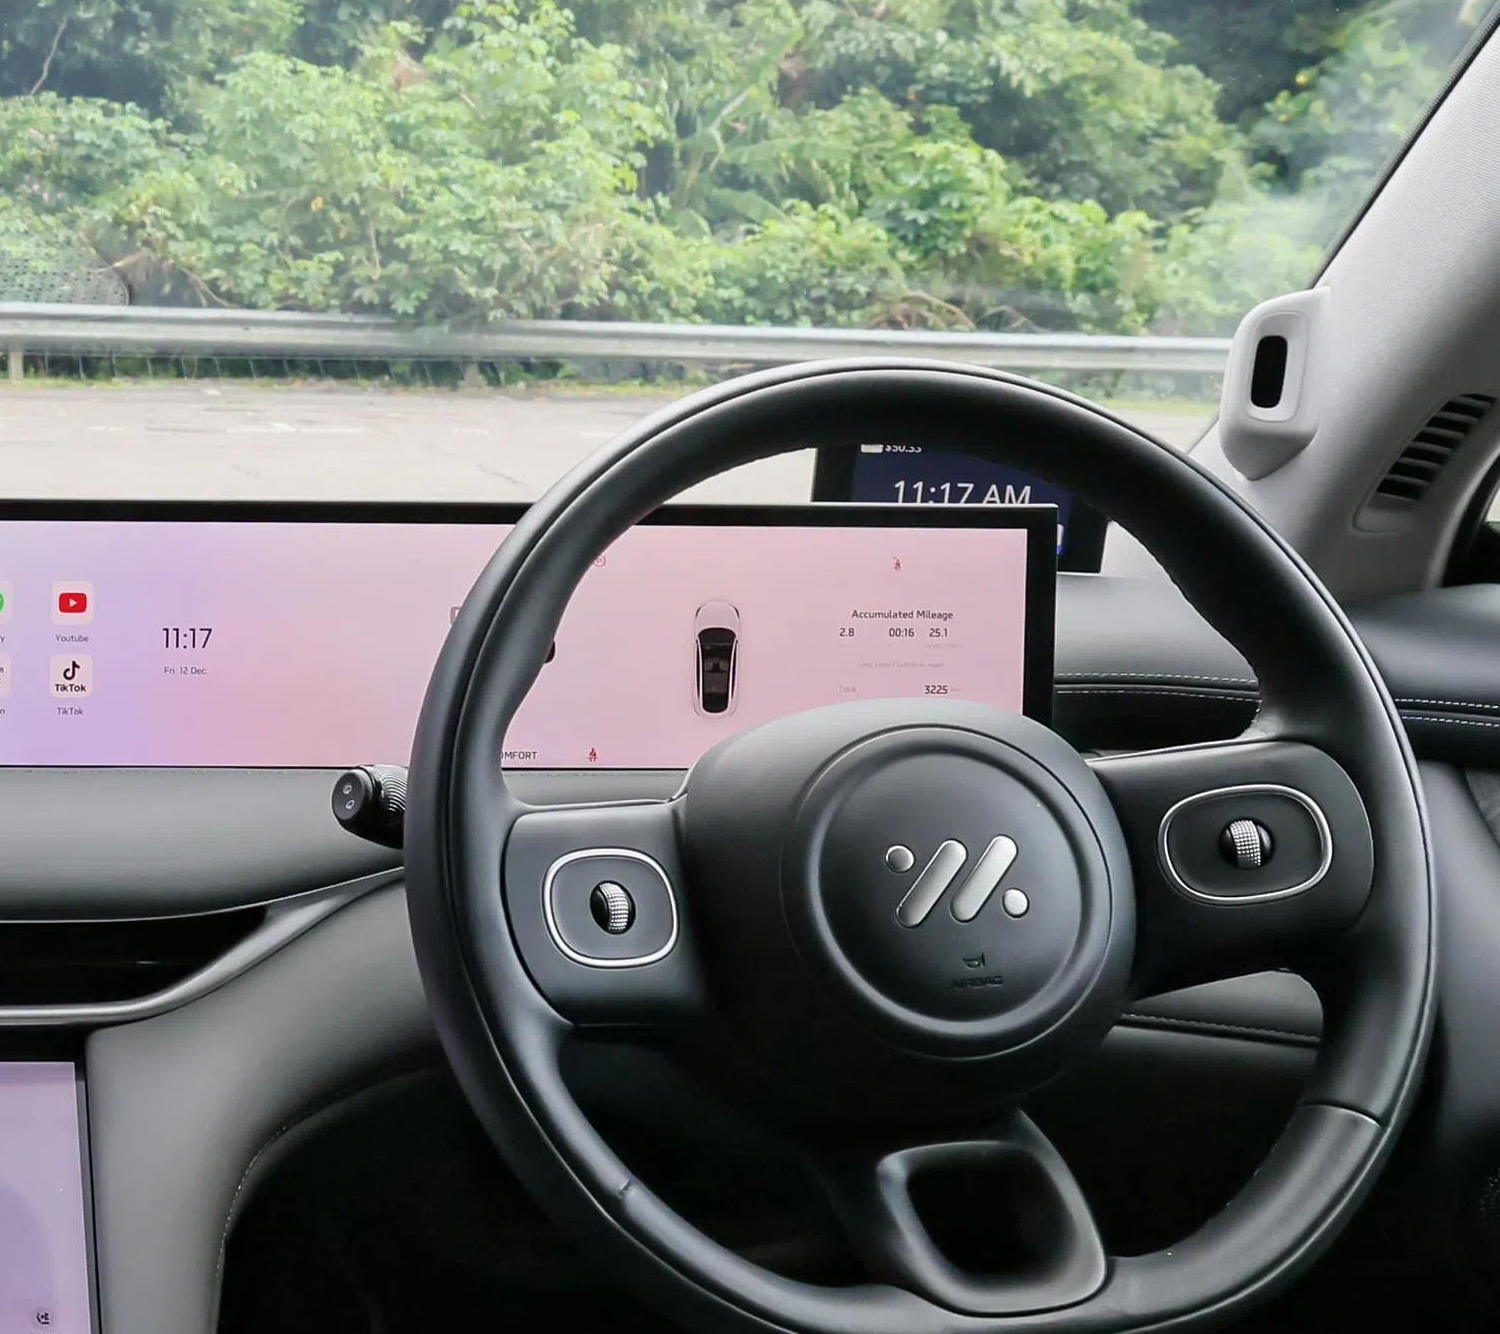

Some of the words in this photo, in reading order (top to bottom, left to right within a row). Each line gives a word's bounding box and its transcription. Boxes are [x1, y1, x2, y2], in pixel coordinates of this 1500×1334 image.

[893, 480, 974, 504] 11:17
[982, 484, 1032, 504] AM
[851, 609, 914, 619] Accumulated
[916, 610, 954, 621] Mileage
[839, 627, 855, 637] 2.8
[888, 627, 915, 637] 00:16
[929, 628, 948, 637] 25.1
[55, 634, 90, 643] Youtube
[162, 628, 213, 649] 11:17
[180, 666, 188, 674] 12
[55, 683, 87, 692] TikTok
[924, 685, 948, 695] 3225
[57, 707, 84, 715] TikTok
[501, 751, 537, 759] MFORT
[951, 976, 1004, 989] AIRBAG
